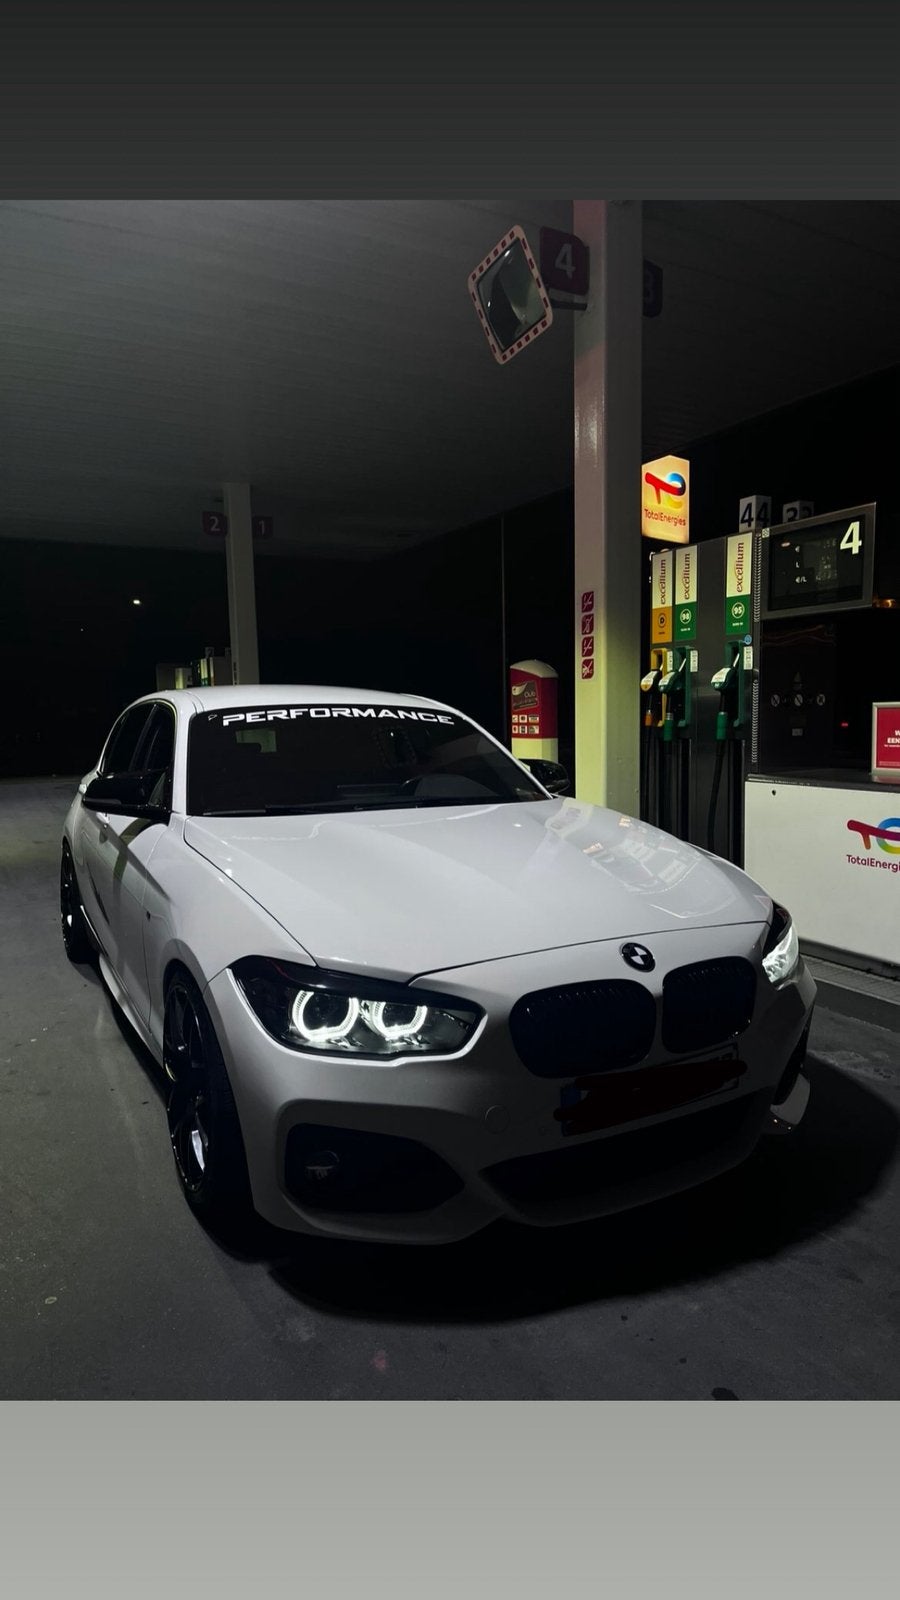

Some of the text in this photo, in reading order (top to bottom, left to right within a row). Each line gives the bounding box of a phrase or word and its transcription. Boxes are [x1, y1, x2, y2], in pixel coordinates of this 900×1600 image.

[555, 243, 576, 279] 4
[209, 516, 220, 532] 2
[644, 508, 686, 527] TotalEnergies
[741, 502, 754, 527] 4
[758, 502, 769, 528] 4
[258, 519, 265, 537] 1
[840, 521, 862, 555] 4
[682, 553, 691, 600] excellium
[735, 542, 744, 592] excellium
[733, 606, 743, 615] 95
[222, 708, 455, 727] PERFORMANCE
